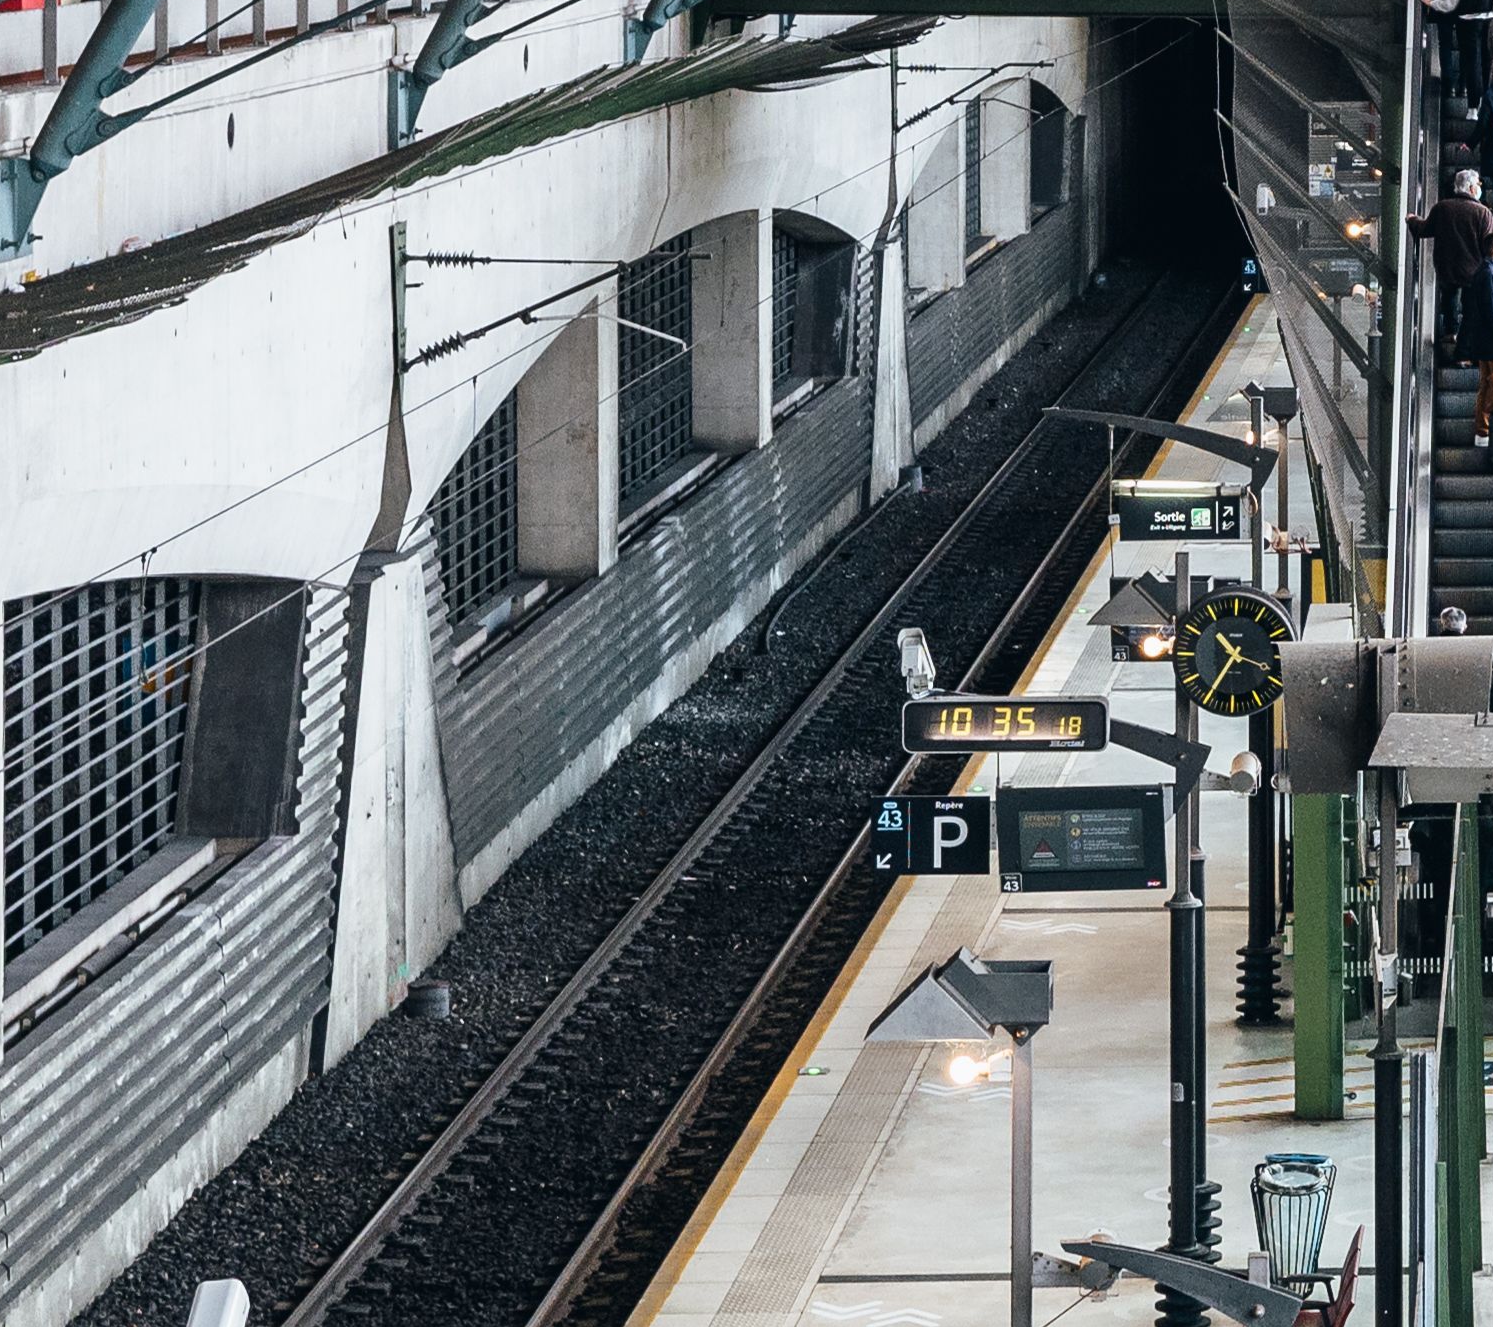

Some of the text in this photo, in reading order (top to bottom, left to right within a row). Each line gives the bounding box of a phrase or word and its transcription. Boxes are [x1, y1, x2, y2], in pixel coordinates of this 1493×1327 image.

[1154, 511, 1186, 523] Sortie
[1113, 651, 1127, 661] 43
[939, 707, 1082, 736] 10 35 18
[935, 801, 964, 810] Repère
[877, 810, 903, 827] 43
[933, 815, 969, 869] P
[1003, 881, 1020, 891] 43
